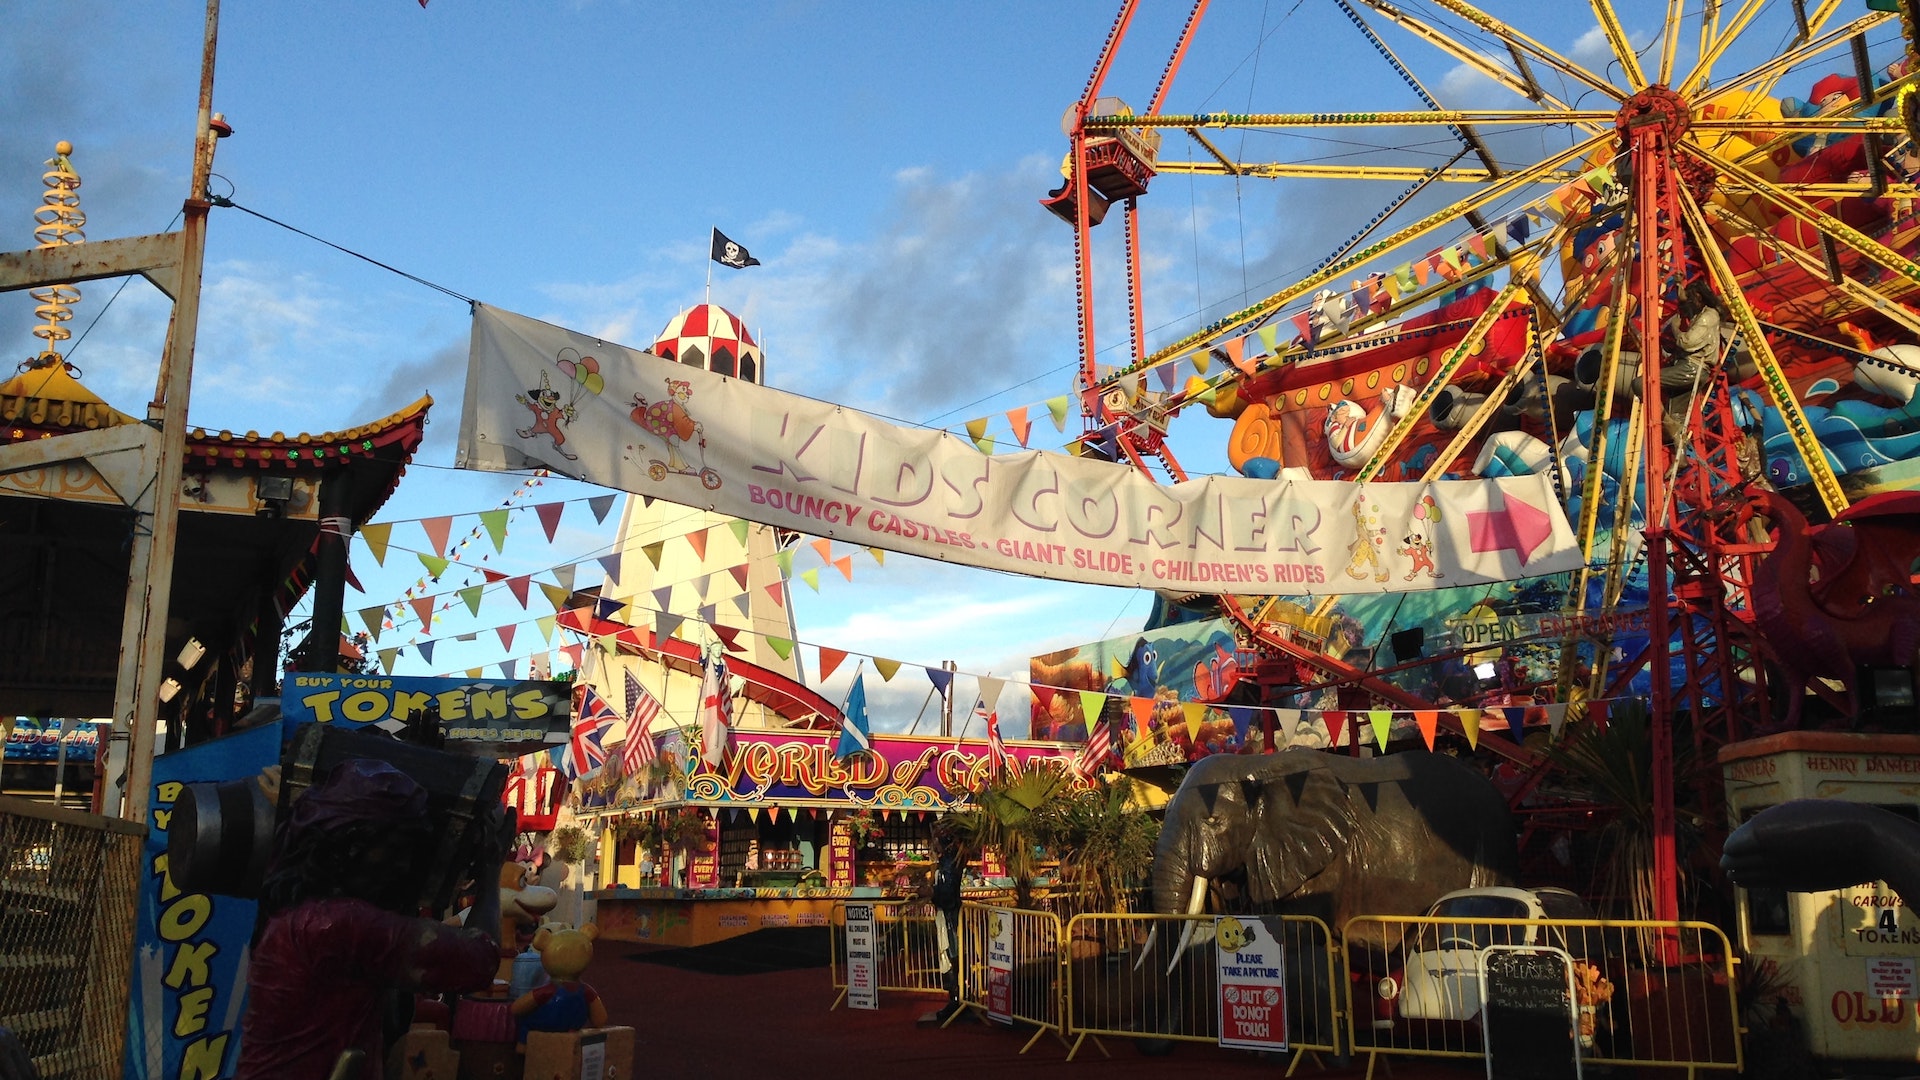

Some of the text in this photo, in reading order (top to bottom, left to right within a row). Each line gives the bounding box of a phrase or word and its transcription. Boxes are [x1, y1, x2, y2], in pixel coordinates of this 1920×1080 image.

[750, 407, 1322, 556] KIDS CORNER
[747, 484, 1325, 584] BOUNCY CASTLES GIANT SLIDE CHILDREN'S RIDES
[1463, 622, 1514, 644] OPEN
[295, 677, 392, 690] BUY YOUR
[302, 689, 548, 723] TOKENS
[449, 727, 499, 739] RIDES
[501, 728, 543, 739] HERE
[702, 740, 889, 796] WORLD
[893, 746, 941, 794] of
[1806, 756, 1858, 776] HENRY
[832, 836, 851, 847] EVERY
[834, 847, 849, 857] TIME
[693, 865, 714, 873] EVERY
[695, 874, 711, 882] TIME
[756, 888, 853, 898] WIN A GOLDFISH
[847, 906, 869, 920] NOTICE
[1879, 909, 1897, 933] 4
[1856, 929, 1920, 944] TOKENS
[1236, 953, 1263, 965] PLEASE
[1222, 966, 1279, 978] TAKE A PICTURE
[1241, 989, 1262, 1004] BUT
[1233, 1006, 1271, 1021] DO NOT
[1832, 990, 1904, 1024] OLD
[1235, 1021, 1270, 1037] TOUCH
